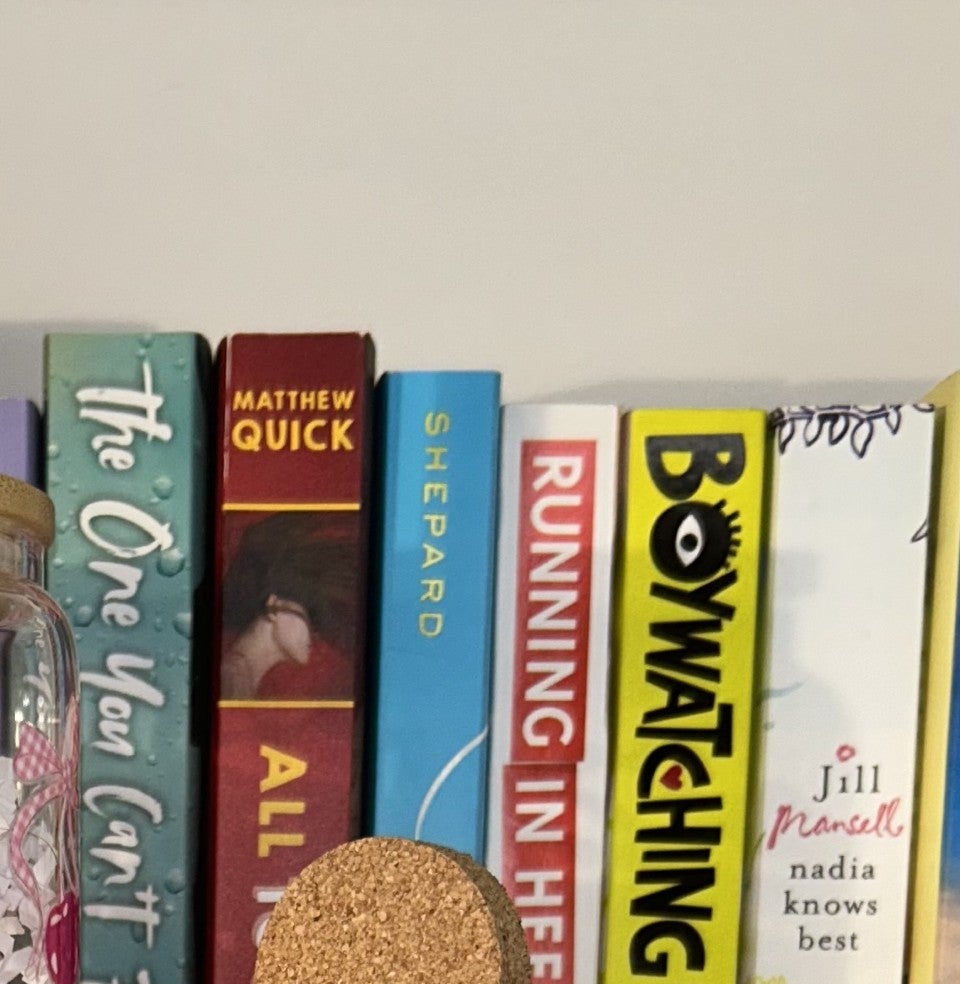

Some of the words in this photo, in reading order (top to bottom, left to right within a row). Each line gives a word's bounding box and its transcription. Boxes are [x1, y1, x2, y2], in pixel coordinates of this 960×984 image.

[231, 389, 355, 412] MATTHEW
[231, 417, 355, 452] QUICK
[418, 411, 451, 638] SHEPARD
[79, 500, 174, 627] One
[520, 455, 585, 749] RUNNING
[81, 653, 164, 757] You
[629, 432, 747, 978] BOYWATCHING
[257, 744, 308, 858] ALL
[812, 744, 881, 803] Jill
[515, 780, 565, 843] IN
[766, 797, 904, 850] Mansell
[790, 855, 876, 880] nadia
[783, 890, 878, 915] knows
[798, 926, 859, 951] best
